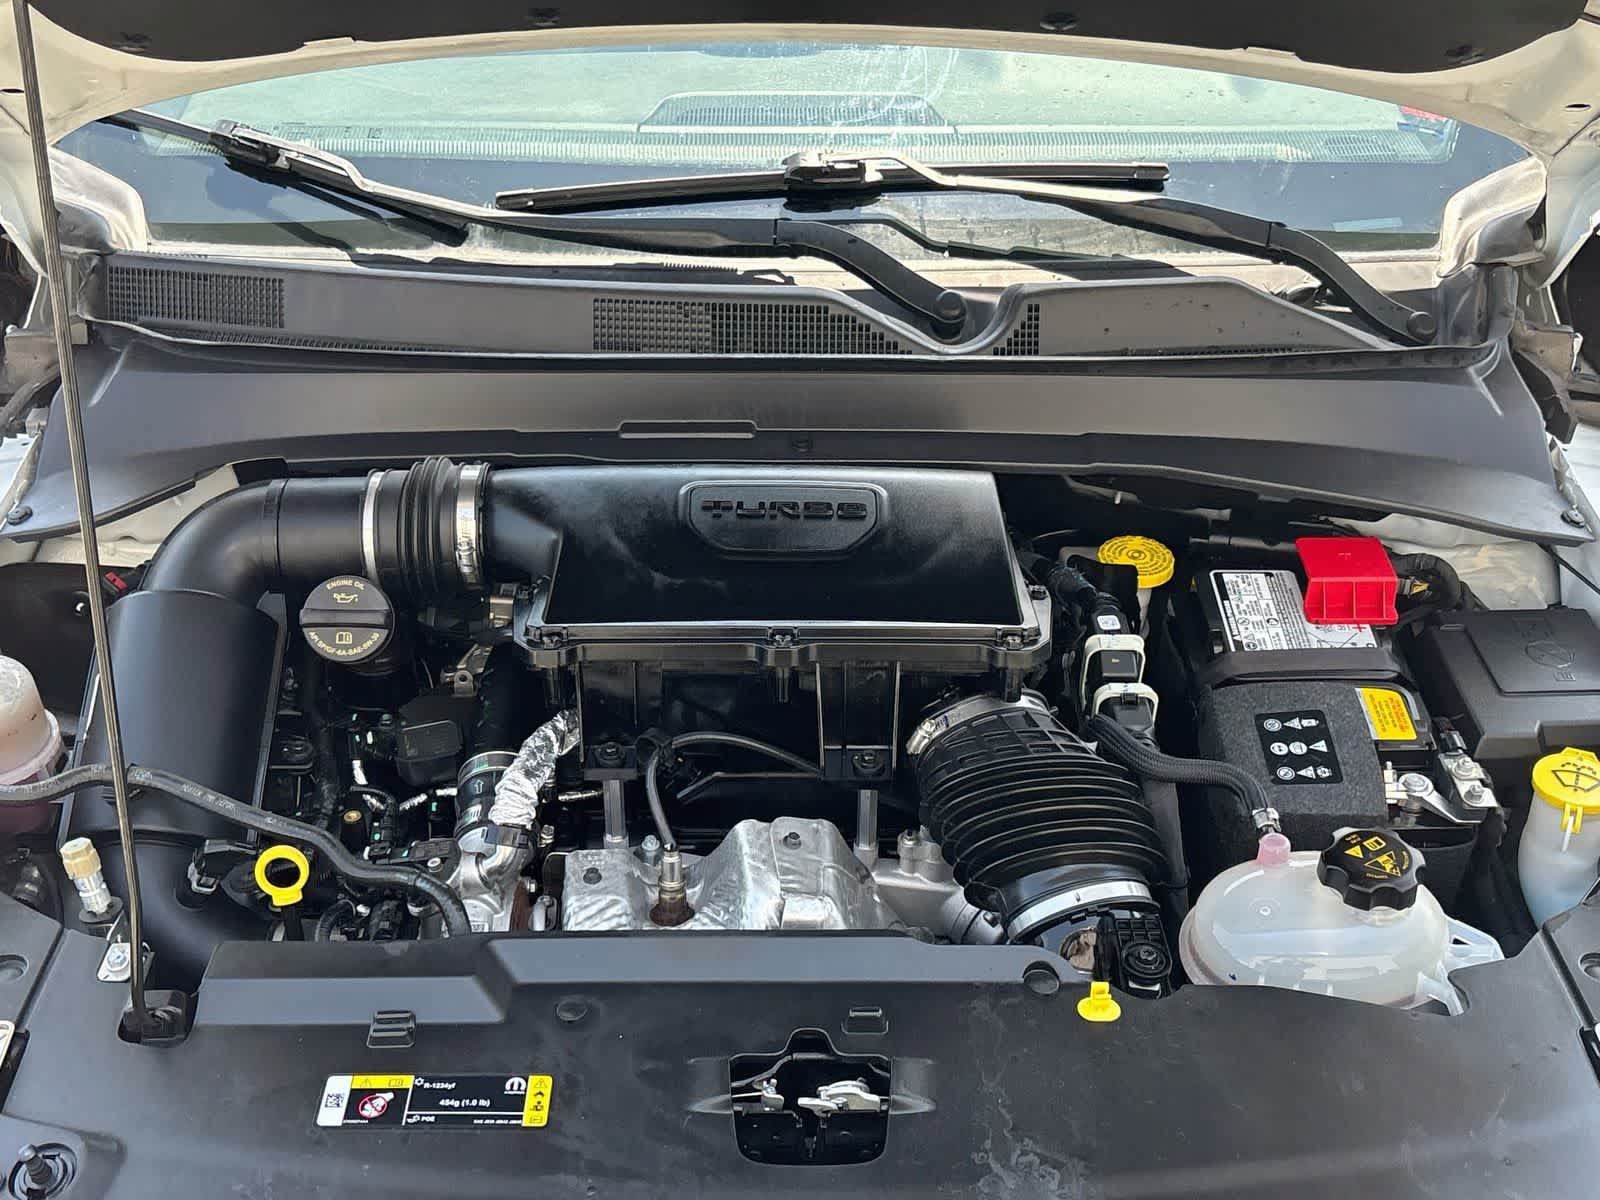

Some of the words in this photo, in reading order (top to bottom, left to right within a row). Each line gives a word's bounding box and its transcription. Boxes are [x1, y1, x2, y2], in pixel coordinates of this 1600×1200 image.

[701, 500, 868, 519] TURBO
[327, 580, 353, 590] ENGINE
[354, 581, 365, 590] OIL
[423, 1081, 456, 1090] R-1234yf
[439, 1099, 460, 1107] 454g
[461, 1098, 477, 1107] (1.0
[479, 1098, 490, 1107] lb)
